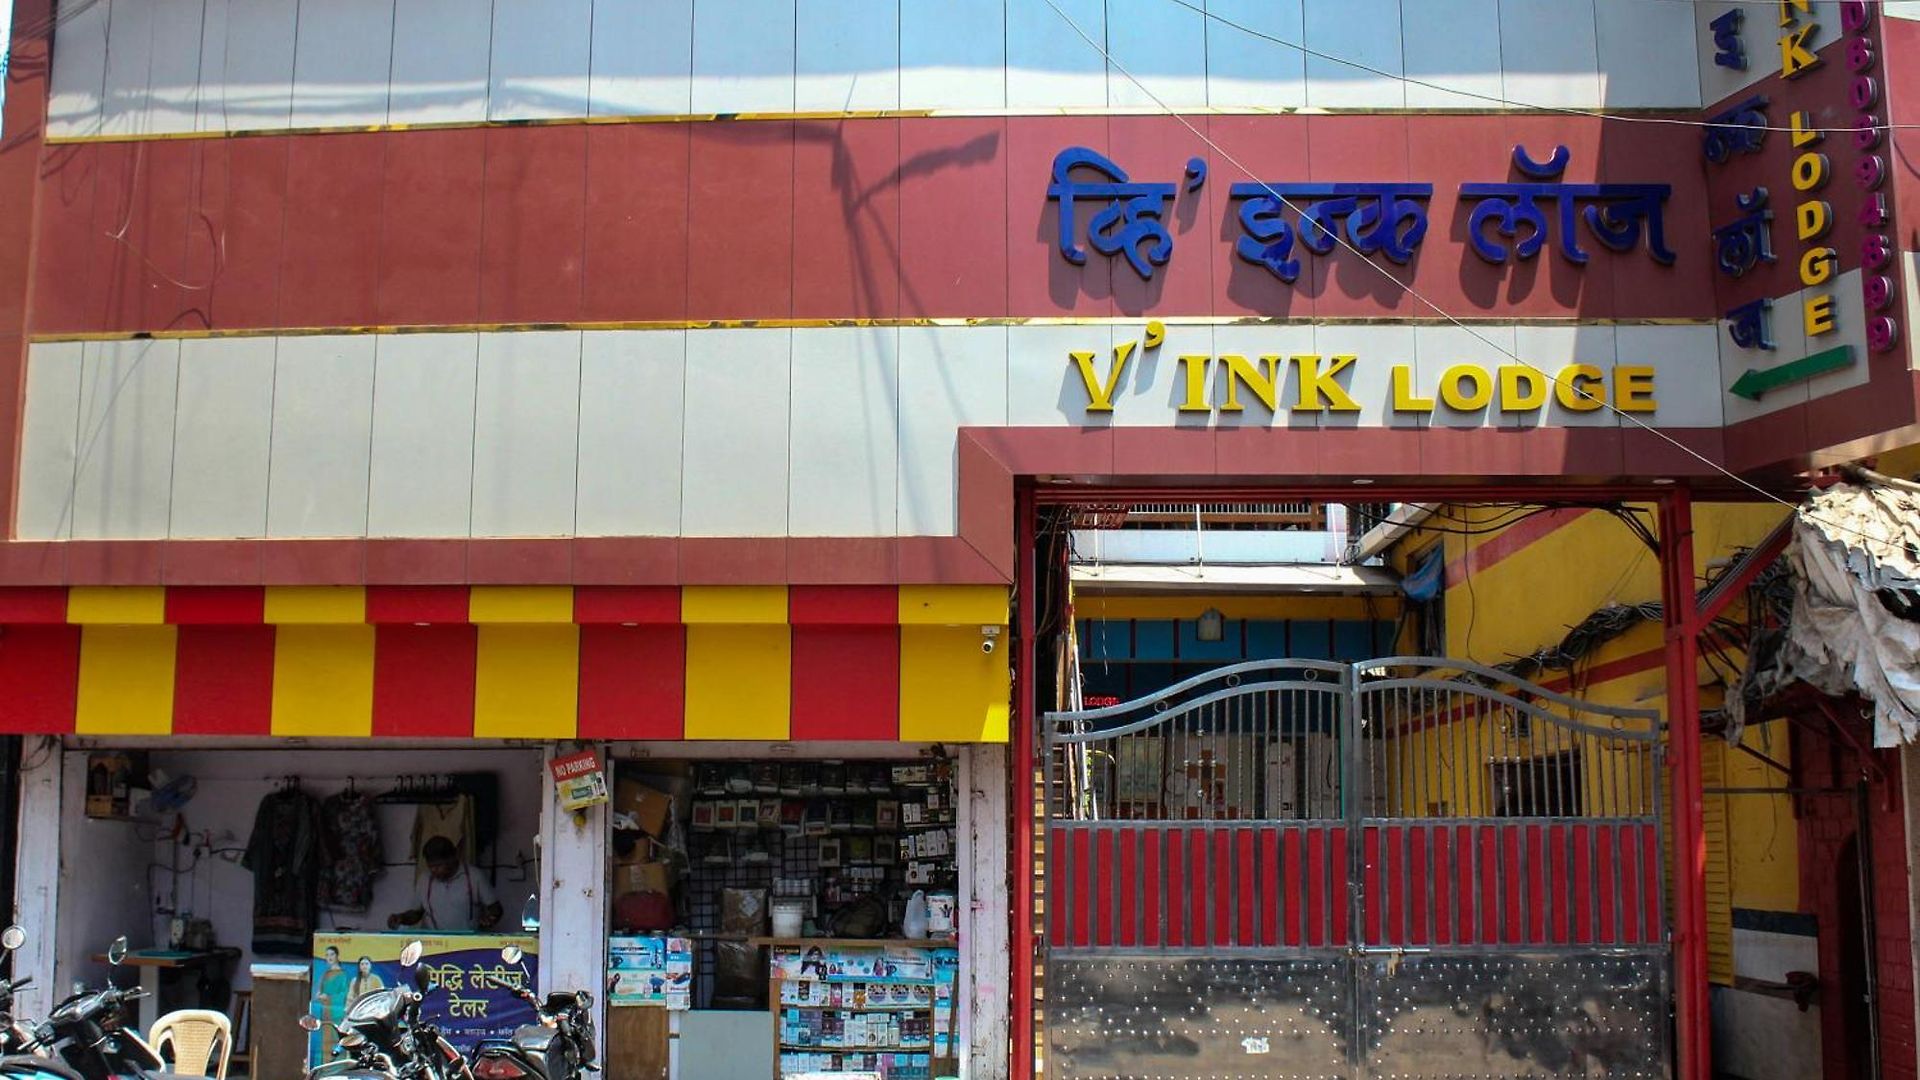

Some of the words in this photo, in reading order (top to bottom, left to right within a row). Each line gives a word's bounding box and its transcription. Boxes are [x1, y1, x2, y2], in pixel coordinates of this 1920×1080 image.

[1230, 181, 1433, 284] इन्क
[1459, 144, 1677, 267] लॉज
[1790, 111, 1838, 337] LODGE
[1392, 363, 1657, 412] LODGE
[555, 766, 566, 778] NO
[567, 757, 596, 775] PARKING
[447, 993, 489, 1019] टेलर
